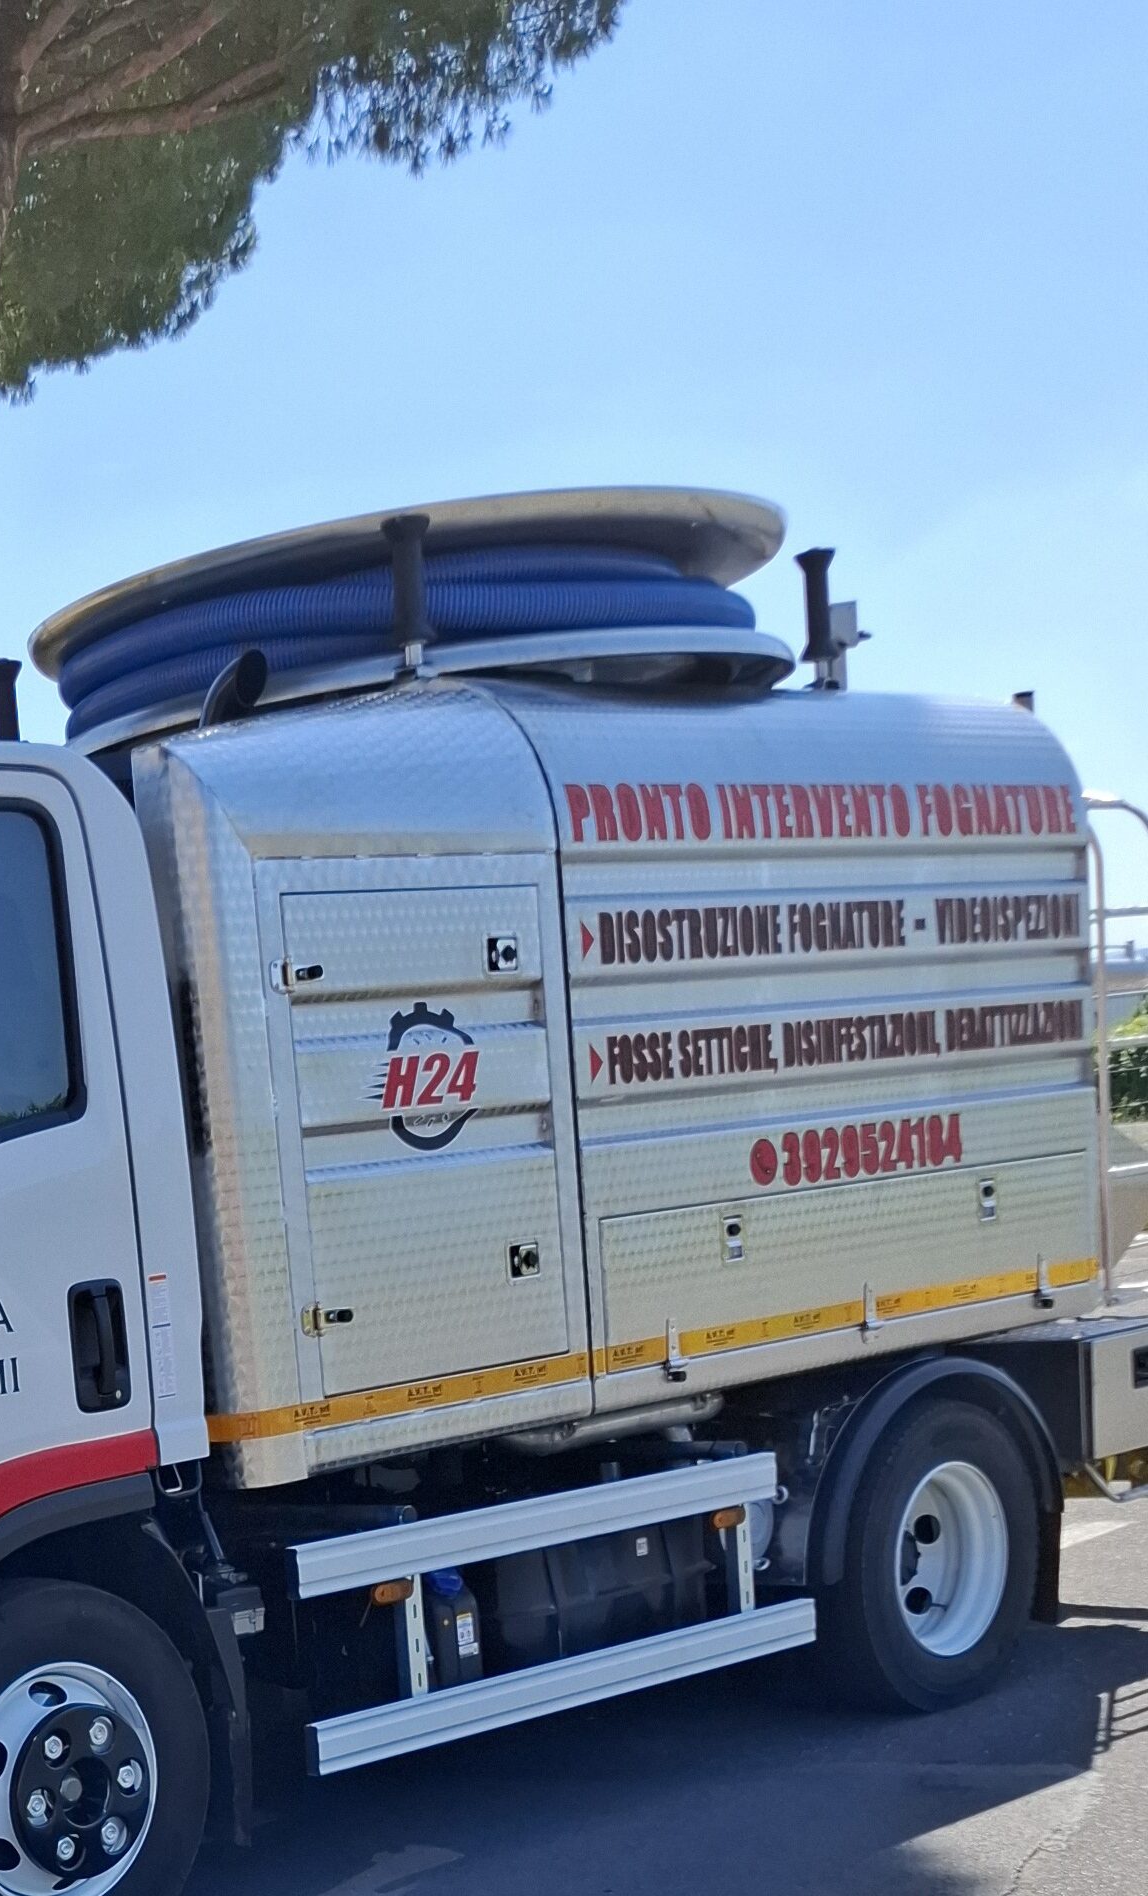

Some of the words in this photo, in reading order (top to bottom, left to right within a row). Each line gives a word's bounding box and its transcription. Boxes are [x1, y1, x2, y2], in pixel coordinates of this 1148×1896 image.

[564, 783, 712, 842] PRONTO
[717, 783, 912, 840] INTERVENTO
[917, 784, 1077, 837] FOGNATURE
[598, 904, 782, 965] DISOSTRUZIONE
[788, 899, 906, 954] FOGNATURE
[381, 1050, 480, 1110] H24
[607, 1031, 674, 1085] FOSSE
